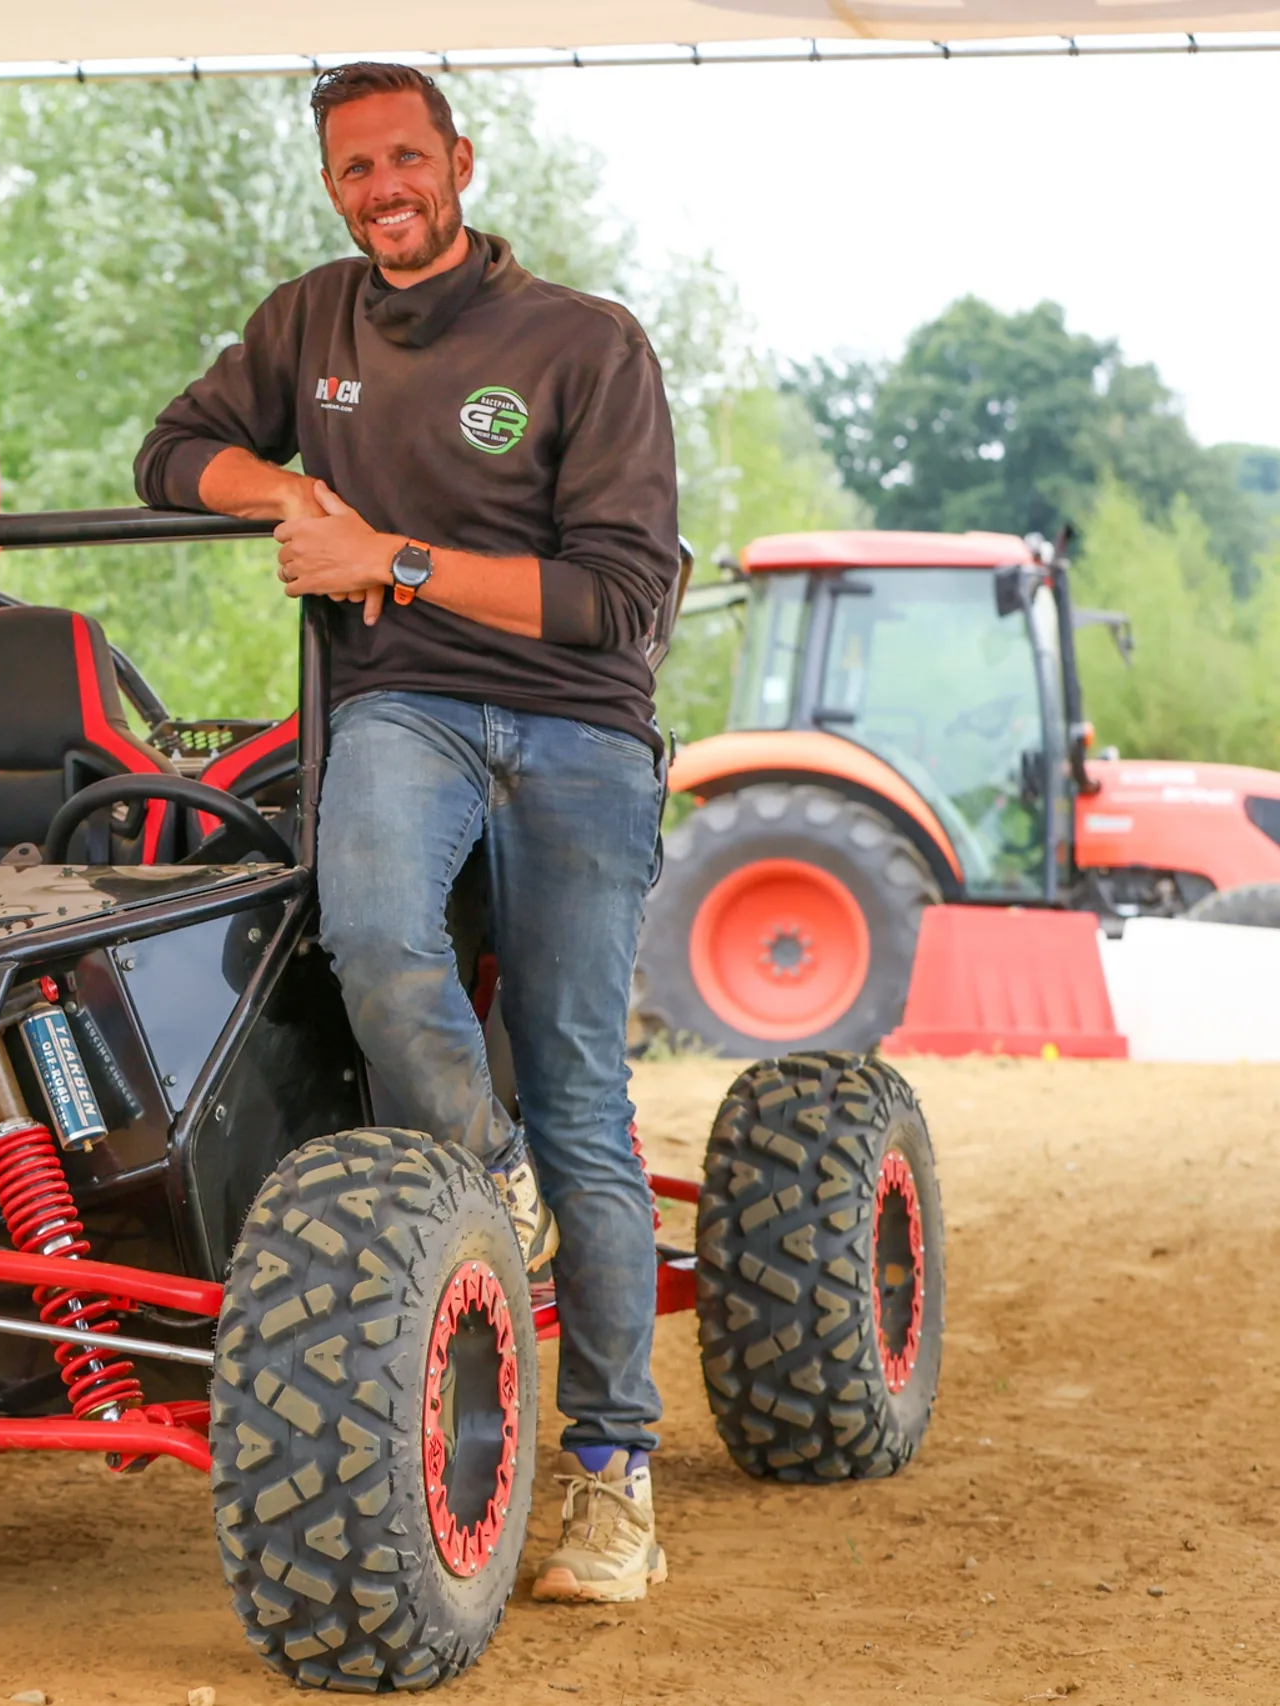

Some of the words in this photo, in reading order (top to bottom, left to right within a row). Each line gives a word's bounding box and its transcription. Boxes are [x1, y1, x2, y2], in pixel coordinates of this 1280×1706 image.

[460, 403, 528, 437] GR
[480, 396, 516, 411] RACEPARK
[42, 1041, 70, 1104] OFF-ROAD
[56, 1026, 97, 1115] YEARBEN
